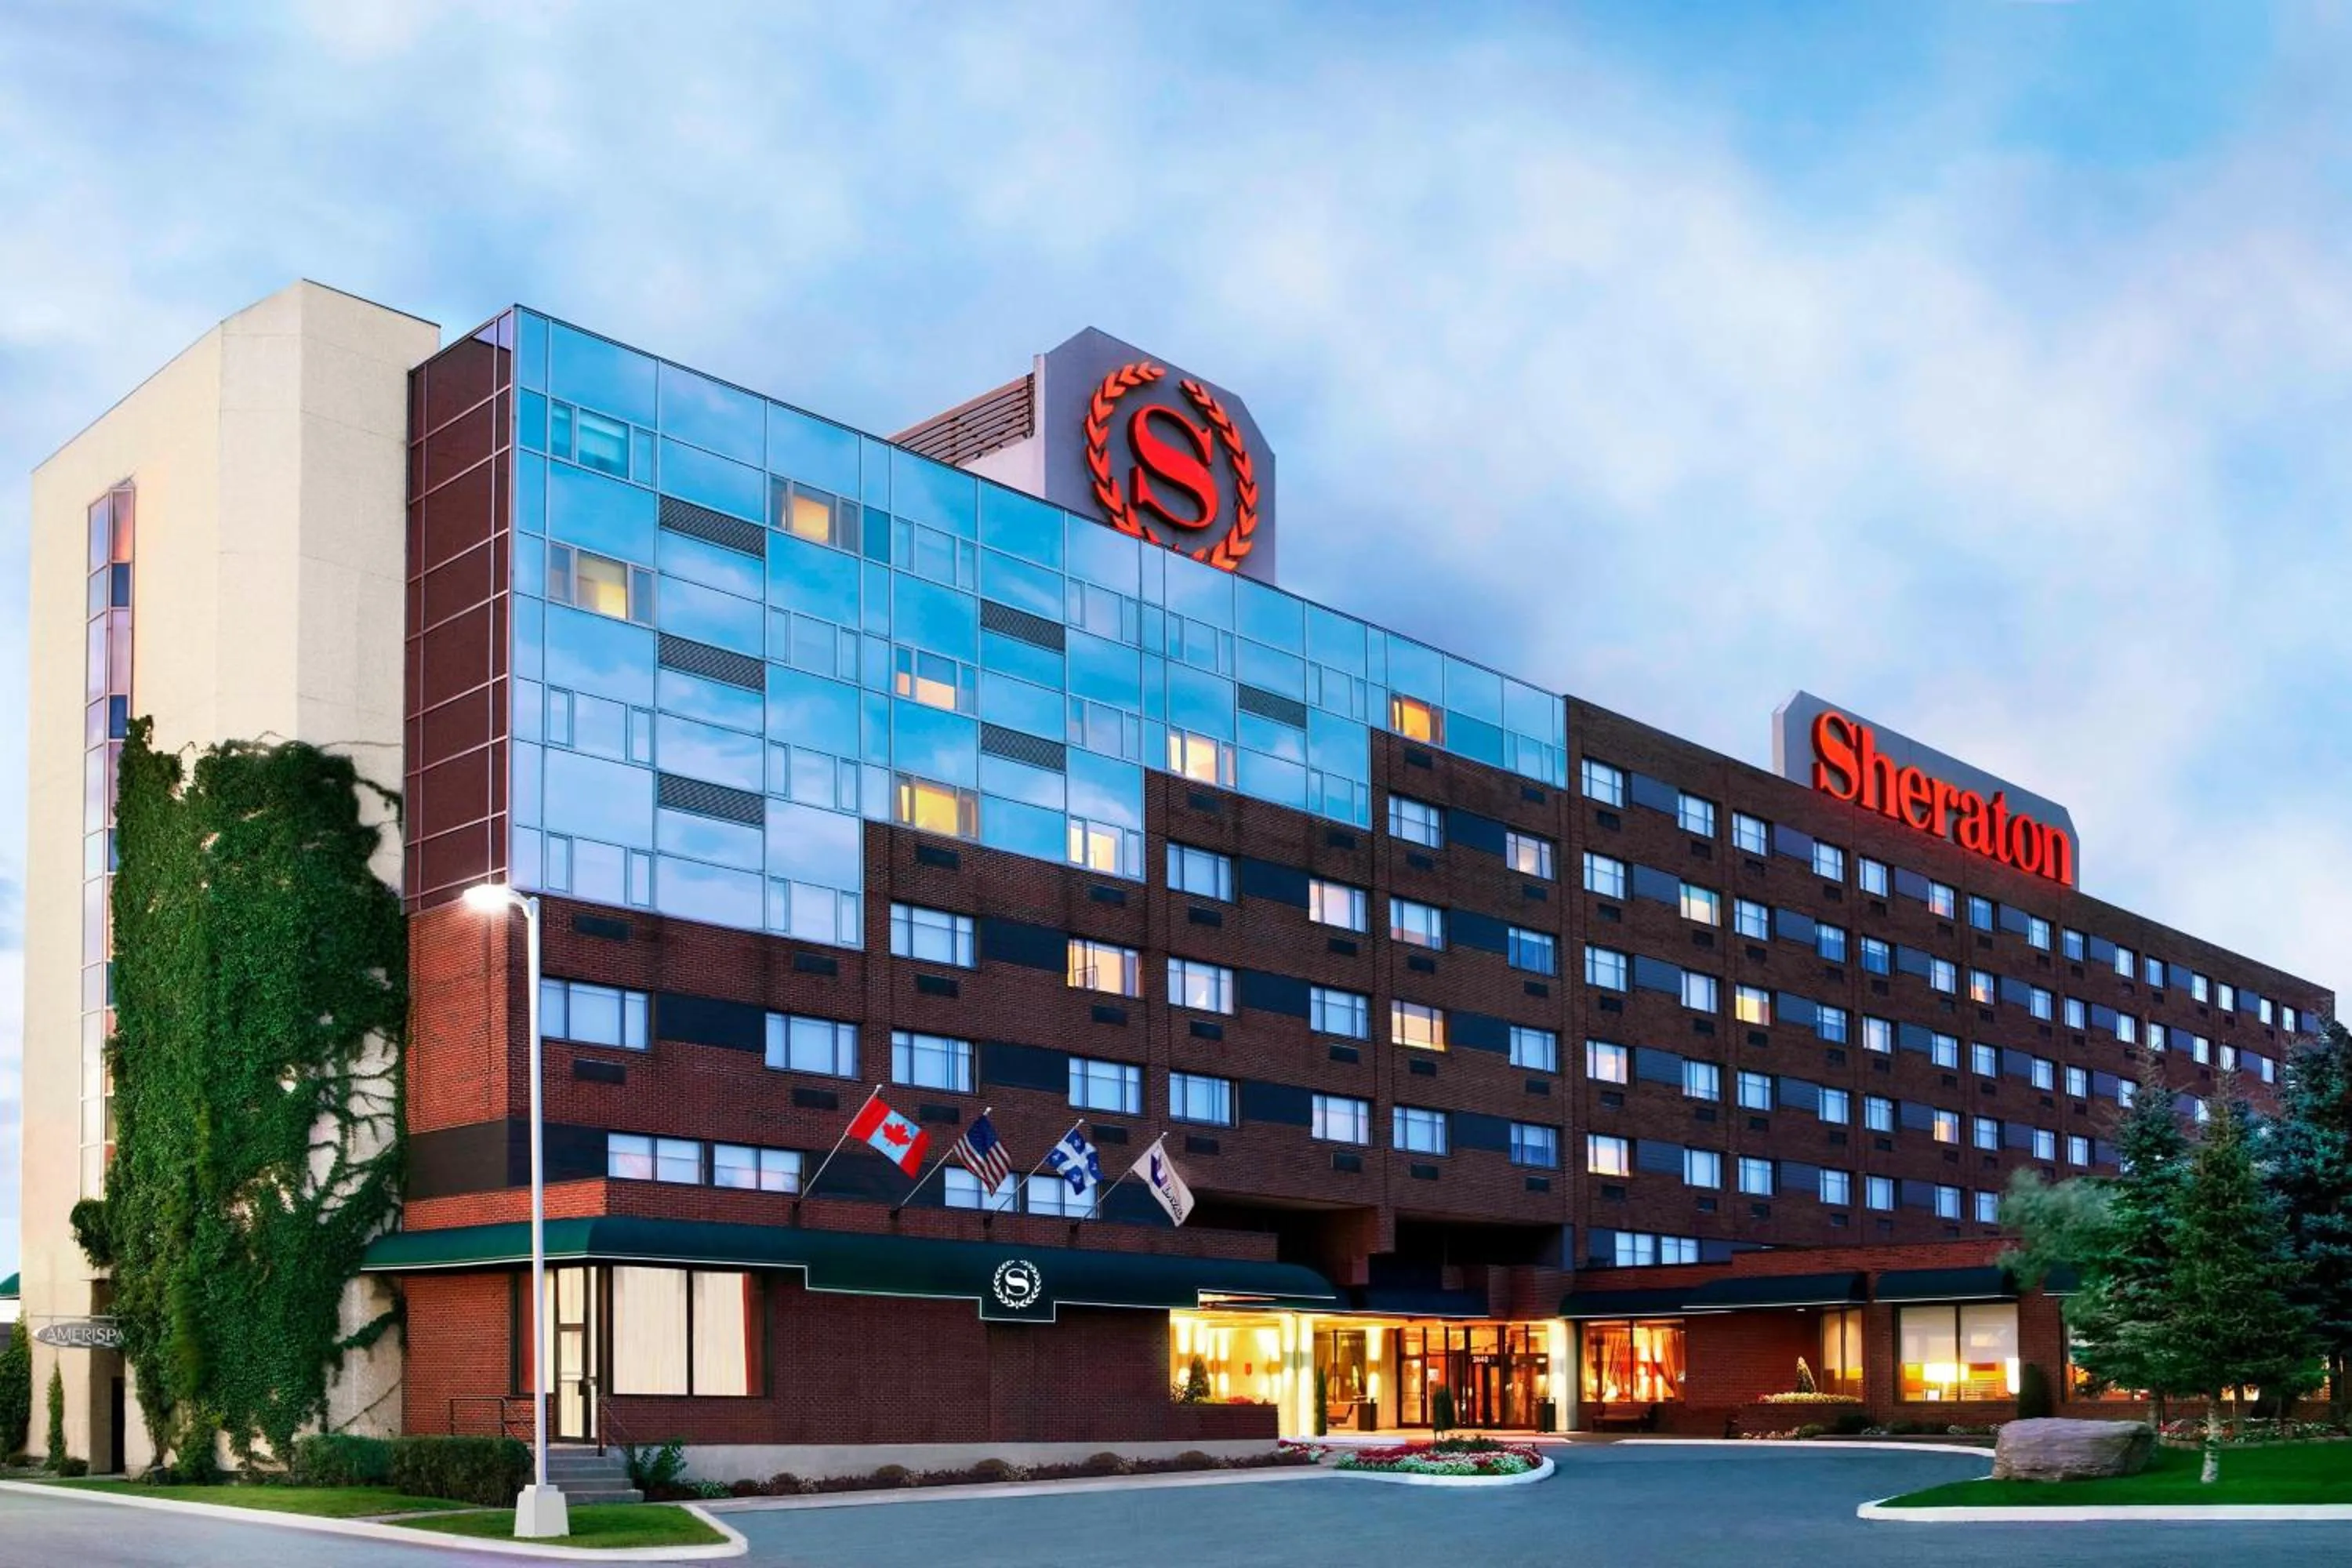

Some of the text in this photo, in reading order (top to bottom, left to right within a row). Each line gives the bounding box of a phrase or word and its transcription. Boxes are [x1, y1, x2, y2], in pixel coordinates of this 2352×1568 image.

[1128, 403, 1219, 531] S
[1812, 710, 2072, 886] Sheraton
[1004, 1267, 1030, 1297] S
[47, 1327, 125, 1341] AMERISPA
